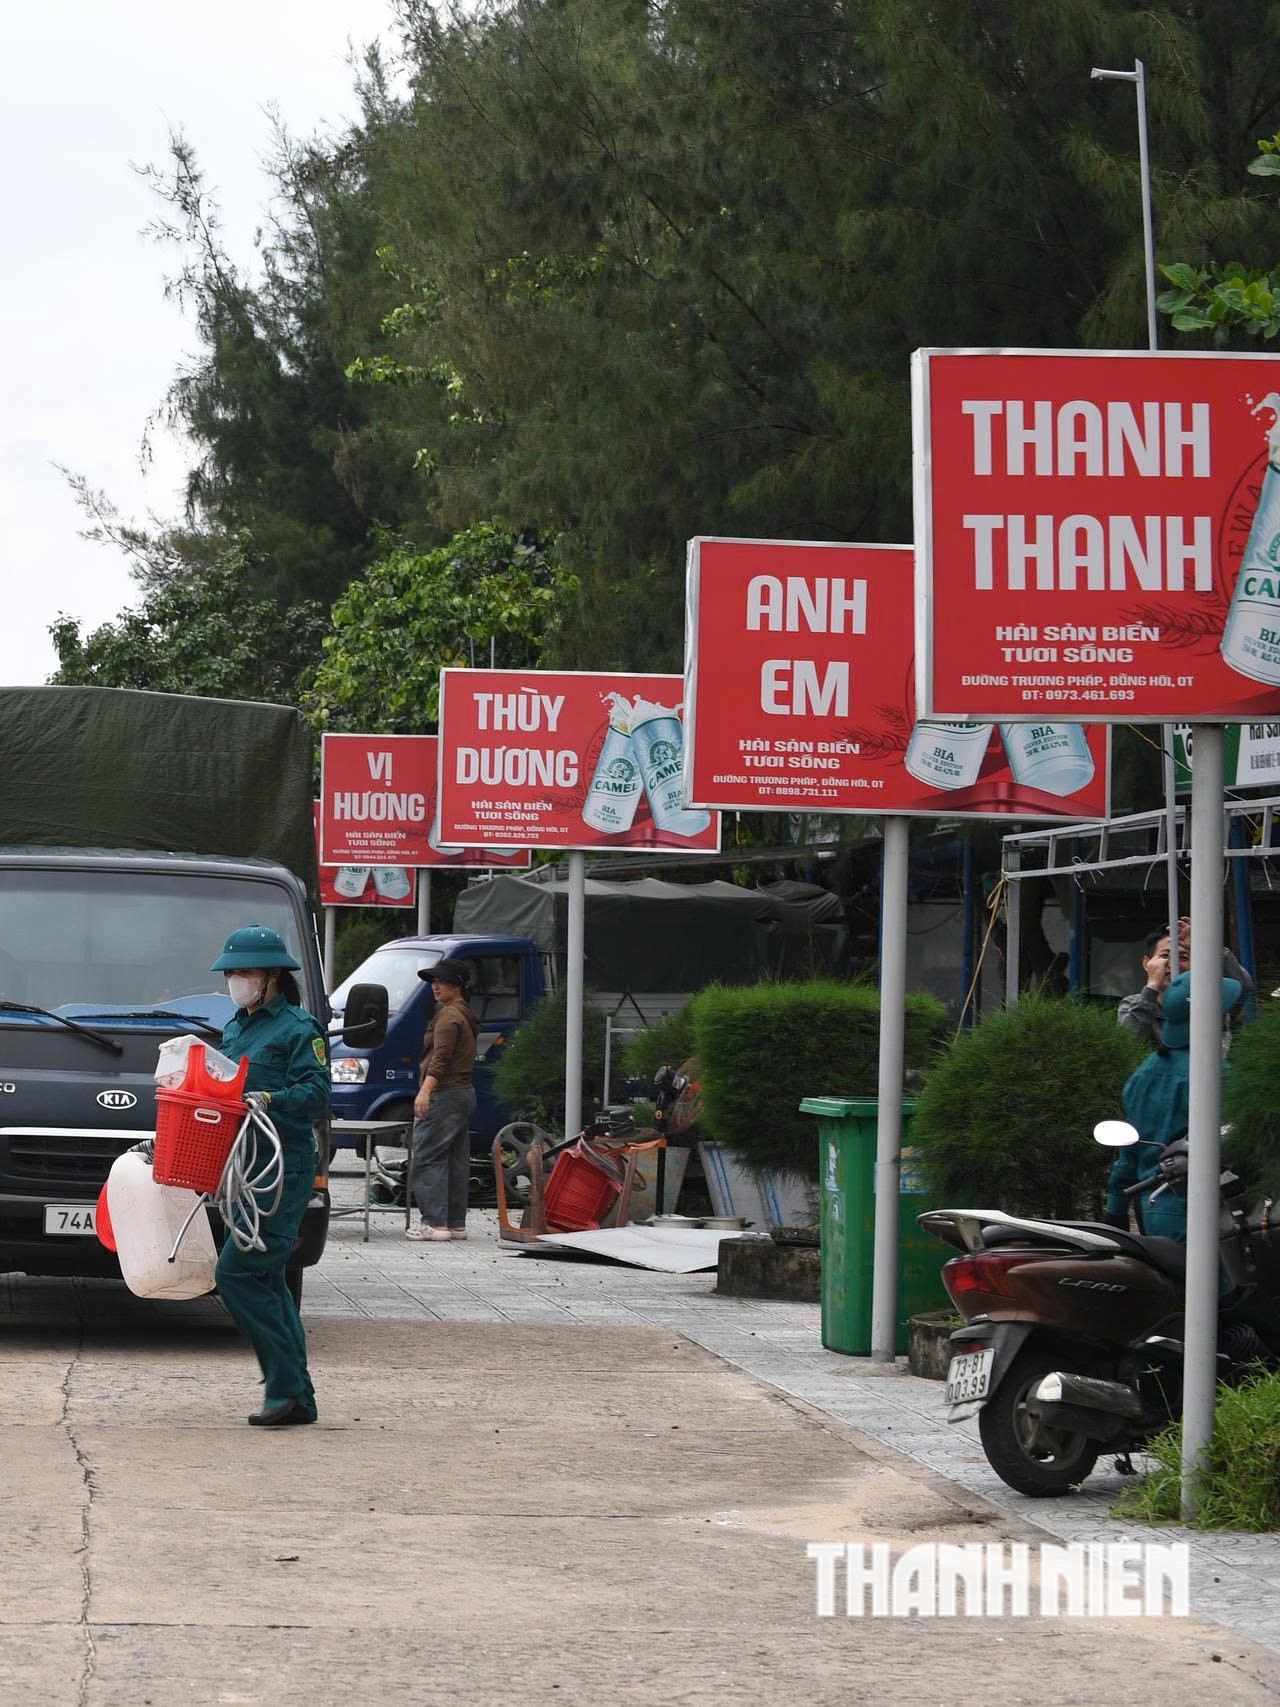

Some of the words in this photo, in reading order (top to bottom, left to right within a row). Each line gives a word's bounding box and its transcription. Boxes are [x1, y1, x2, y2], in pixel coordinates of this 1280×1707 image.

[962, 400, 1210, 477] THANH
[963, 514, 1213, 592] THANH
[746, 574, 868, 635] ANH
[996, 622, 1037, 641] HẢI
[1043, 622, 1097, 642] SẢN
[1102, 621, 1160, 642] BIỂN
[1001, 647, 1057, 663] TƯƠI
[1063, 643, 1134, 663] SỐNG
[760, 659, 850, 717] EM
[961, 674, 1008, 686] ĐƯỜNG
[1011, 674, 1065, 686] TRƯƠNG
[1109, 673, 1147, 687] ĐỒNG
[1022, 690, 1043, 700] ĐT:
[1046, 690, 1134, 701] 0973.461.693
[473, 687, 566, 733] THÙY
[1031, 726, 1055, 740] BIA
[739, 737, 770, 751] HẢI
[774, 738, 814, 753] SẢN
[817, 739, 860, 755] BIỂN
[933, 747, 955, 763] BIA
[367, 752, 392, 787] VỊ
[456, 744, 579, 788] DƯƠNG
[743, 754, 784, 768] TƯƠI
[788, 754, 840, 769] SỐNG
[649, 761, 684, 790] CAME
[595, 780, 638, 793] CAMEL
[776, 787, 838, 796] 0898.731.111
[333, 790, 424, 822] HƯƠNG
[471, 800, 492, 809] HẢI
[494, 800, 521, 810] SẢN
[601, 805, 616, 815] BIA
[104, 1093, 130, 1105] KIA
[58, 1211, 94, 1230] 74A
